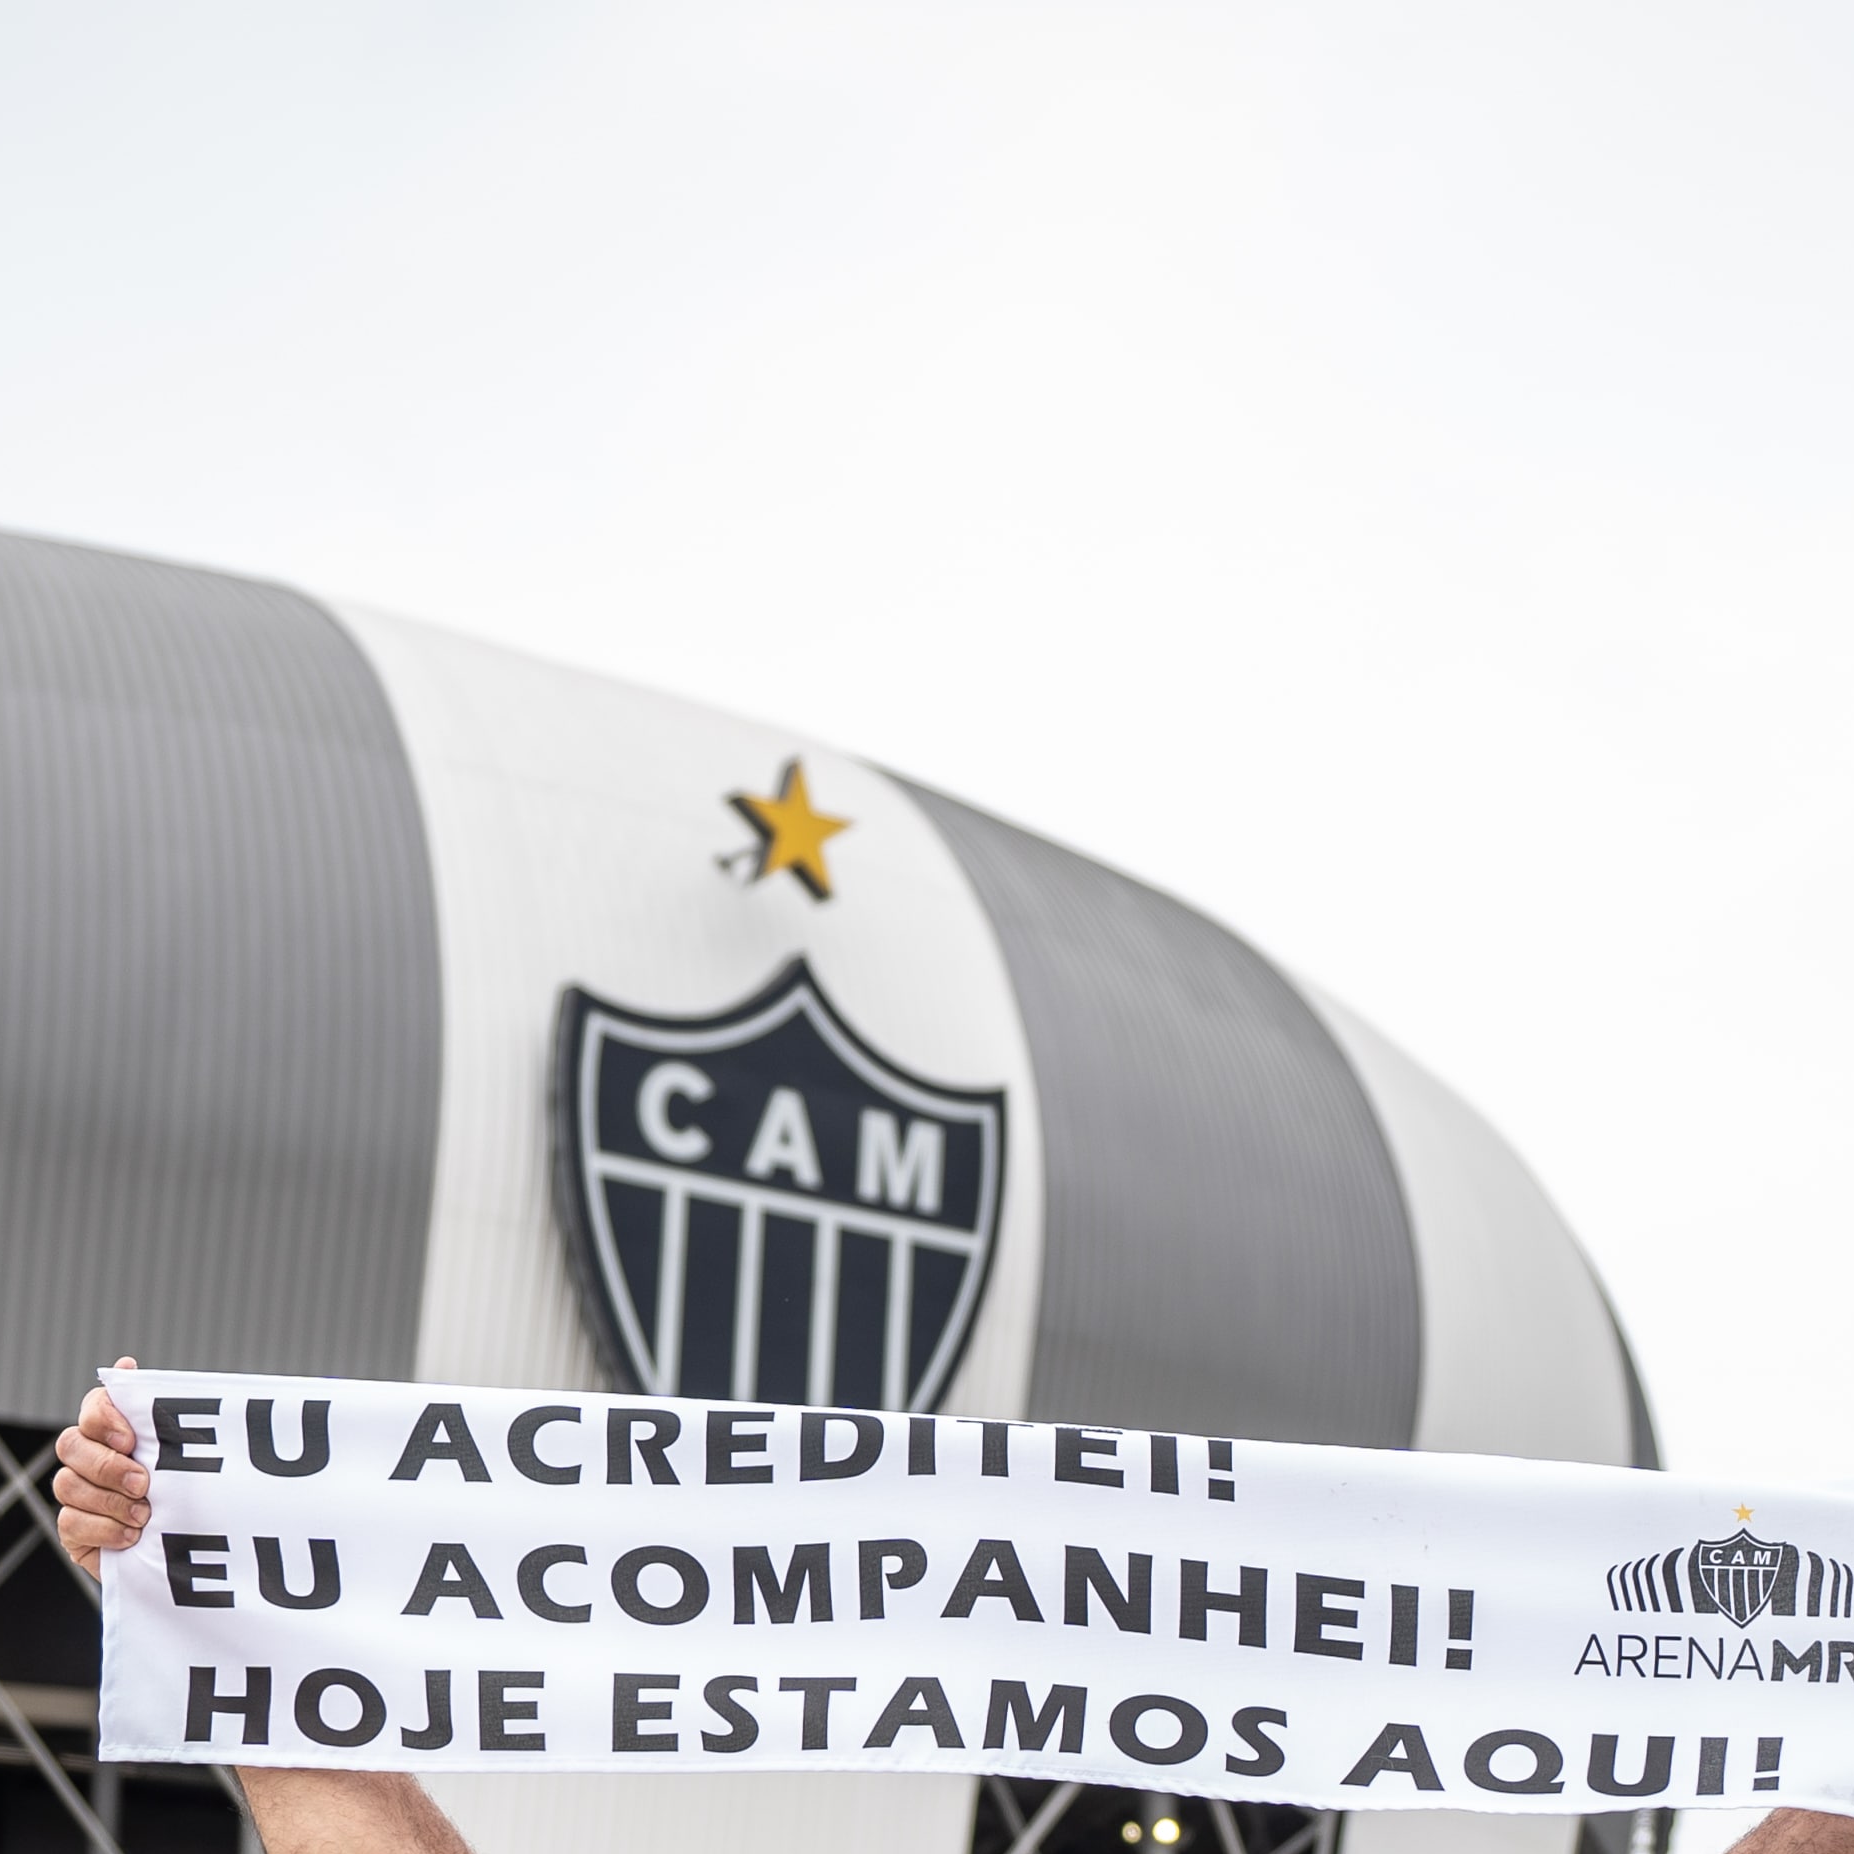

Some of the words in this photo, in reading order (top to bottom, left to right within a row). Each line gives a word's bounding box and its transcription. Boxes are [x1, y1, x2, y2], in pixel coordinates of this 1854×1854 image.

[636, 1060, 945, 1214] CAM
[152, 1397, 331, 1477] EU
[389, 1403, 1235, 1502] ACREDITEI!
[161, 1532, 341, 1610] EU
[400, 1537, 1476, 1671] ACOMPANHEI!
[1709, 1548, 1772, 1565] CAM
[183, 1665, 546, 1751] HOJE
[612, 1670, 1289, 1777] ESTAMOS
[1340, 1722, 1785, 1796] AQUI!
